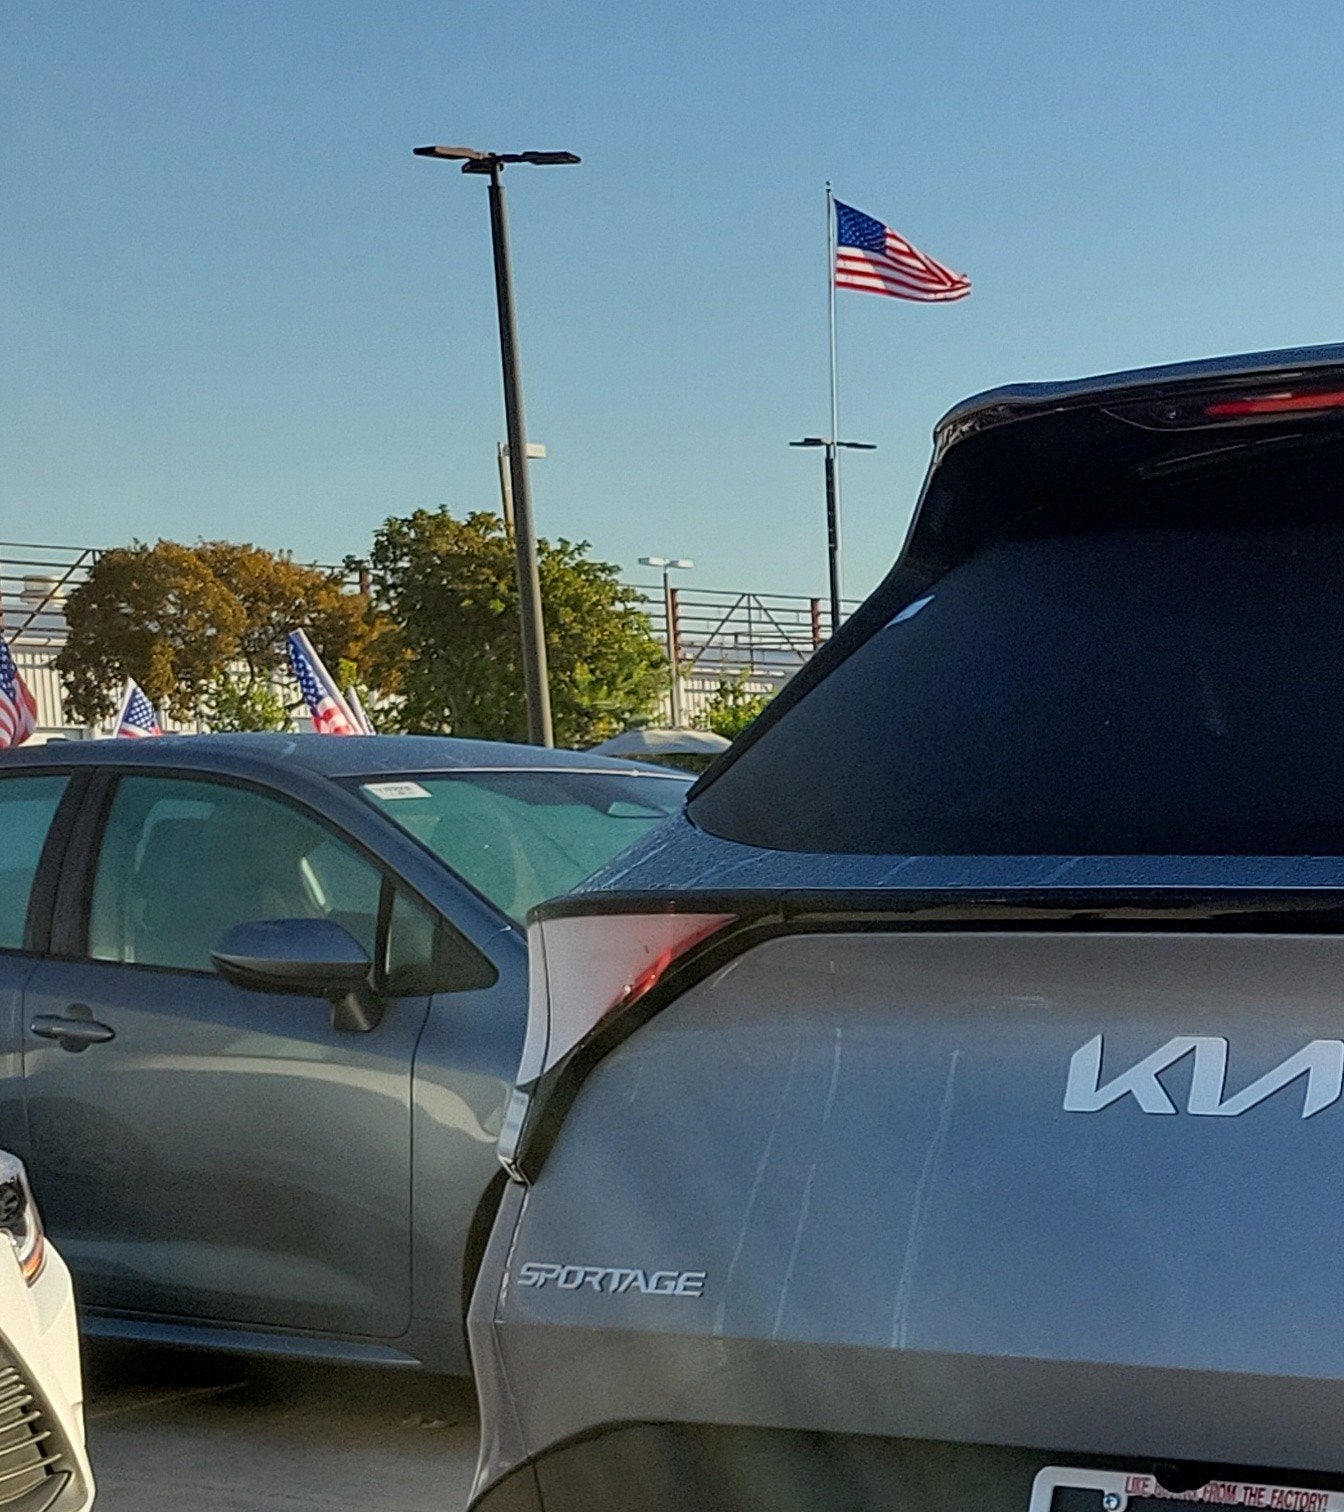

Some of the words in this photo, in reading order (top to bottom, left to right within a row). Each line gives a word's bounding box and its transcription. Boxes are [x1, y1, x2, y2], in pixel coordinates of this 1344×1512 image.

[517, 1262, 707, 1298] SPORTAGE
[1203, 1483, 1236, 1503] FROM
[1242, 1487, 1265, 1506] THE
[1270, 1489, 1329, 1512] FACTORY!
